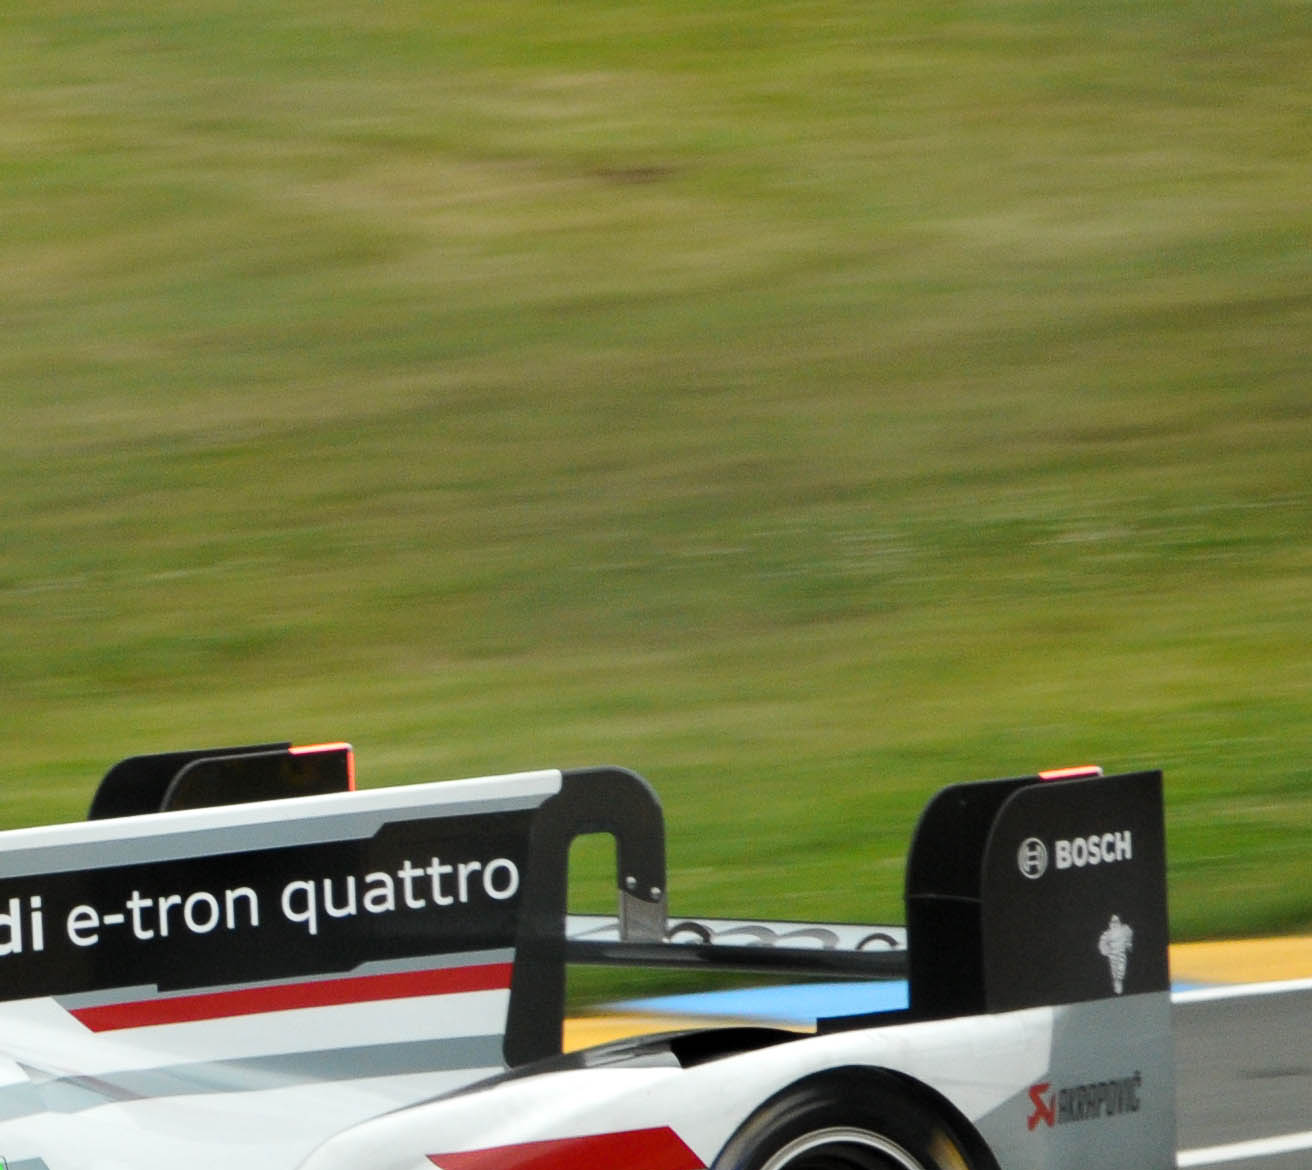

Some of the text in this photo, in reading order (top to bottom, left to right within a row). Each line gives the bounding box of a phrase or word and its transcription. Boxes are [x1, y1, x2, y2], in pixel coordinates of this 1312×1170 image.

[1055, 830, 1133, 870] BOSCH
[66, 886, 260, 947] e-tron
[281, 857, 520, 936] quattro
